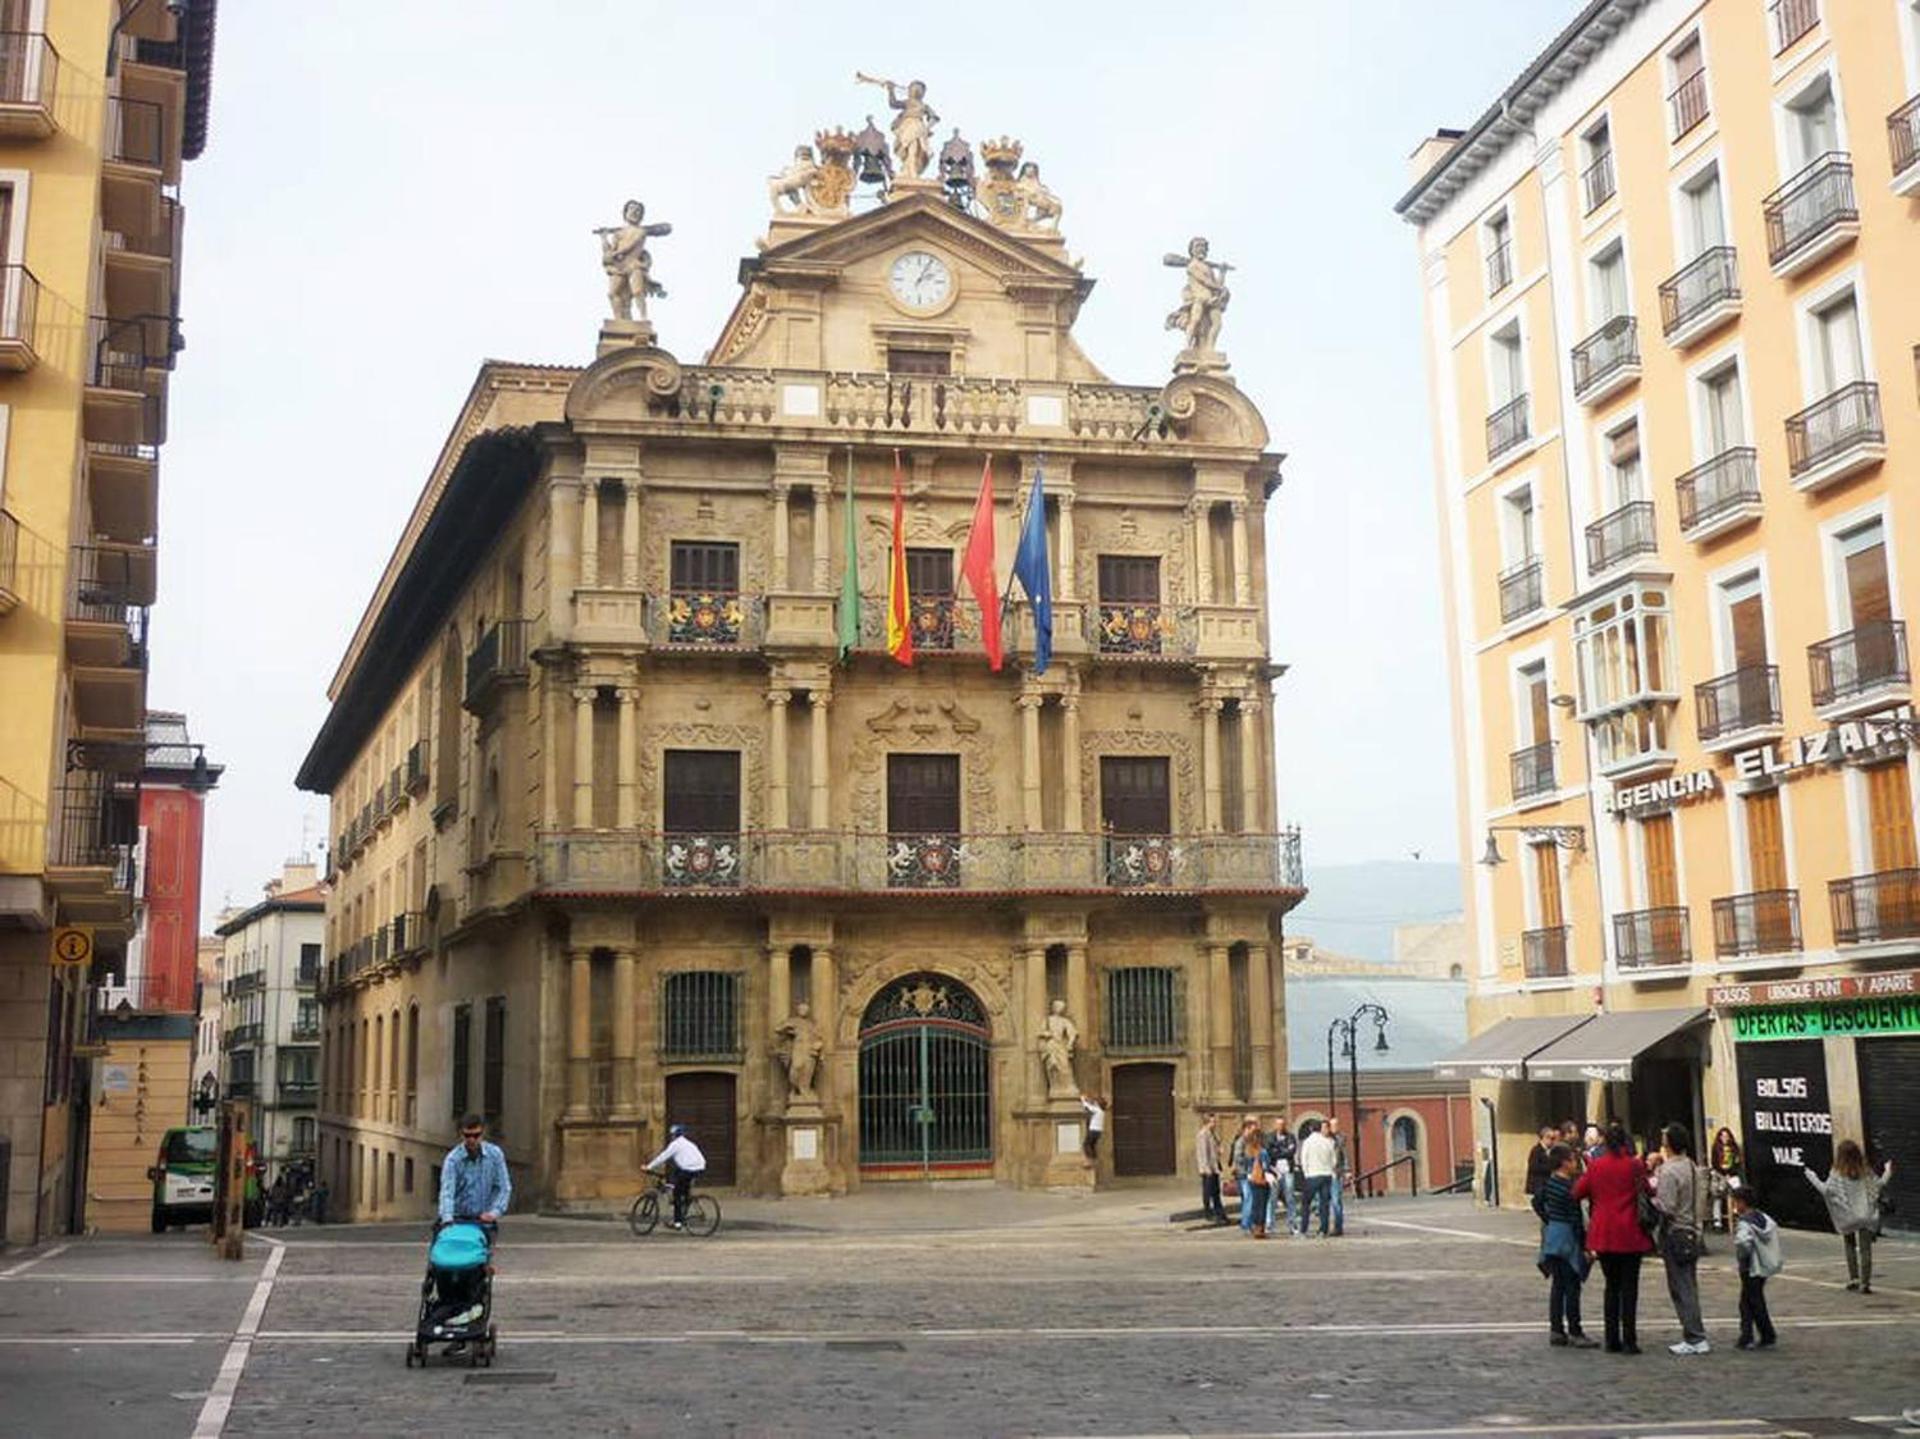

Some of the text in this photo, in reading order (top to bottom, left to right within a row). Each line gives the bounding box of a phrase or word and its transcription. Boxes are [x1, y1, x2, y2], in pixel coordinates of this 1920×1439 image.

[1735, 1010, 1808, 1035] OFERTAS
[1756, 1077, 1808, 1099] BOLSOS
[1755, 1111, 1833, 1135] BILLETEROS
